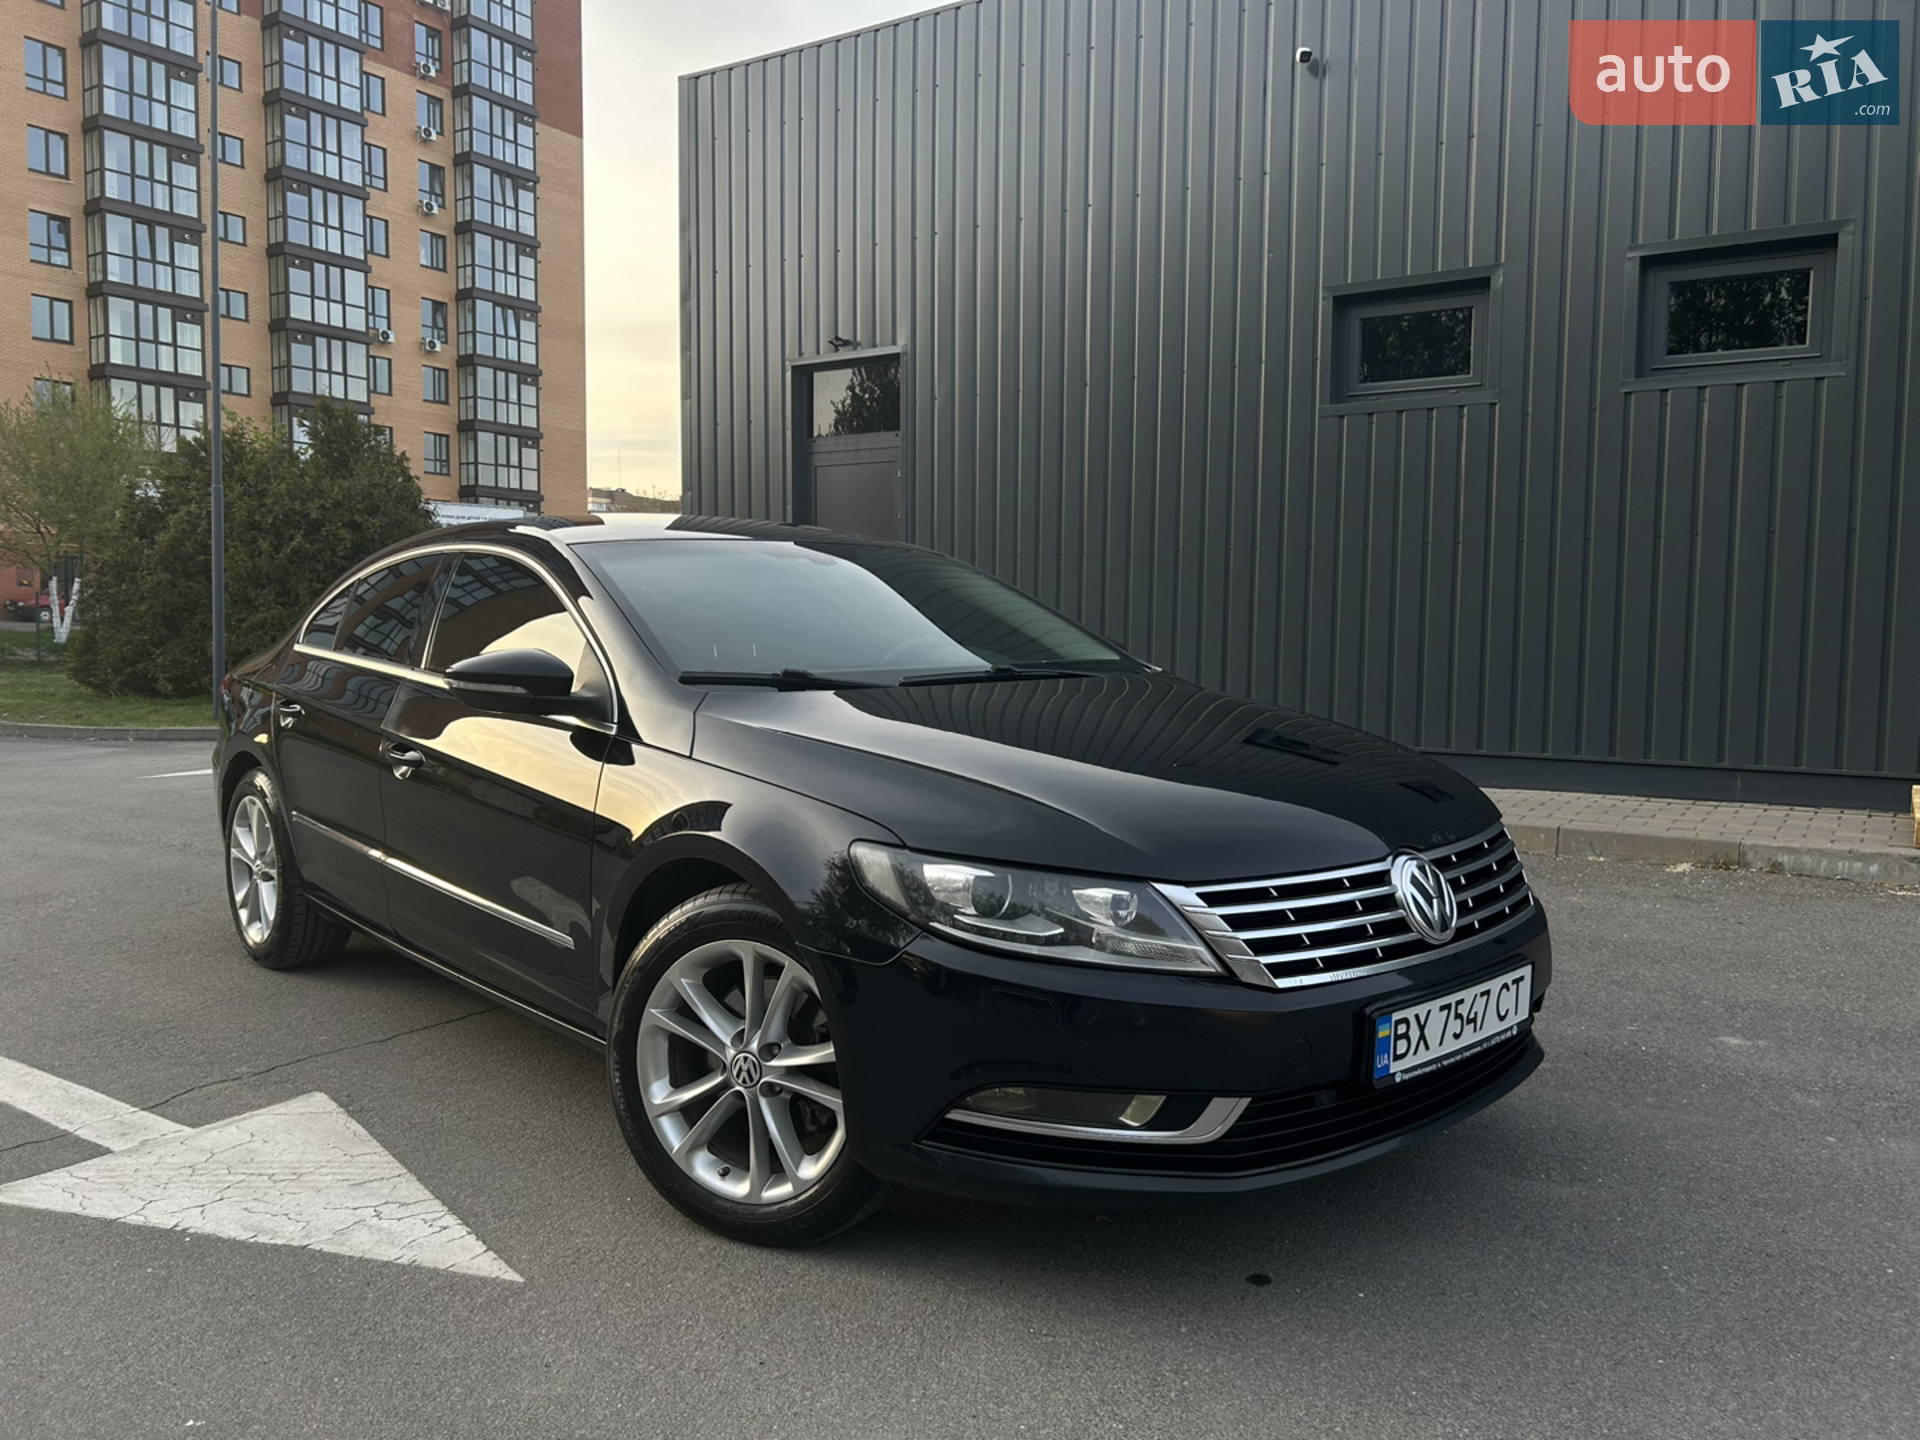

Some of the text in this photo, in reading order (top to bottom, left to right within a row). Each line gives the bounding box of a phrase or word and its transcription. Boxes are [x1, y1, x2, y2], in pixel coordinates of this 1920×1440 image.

[1393, 1009, 1432, 1063] BX
[1438, 988, 1491, 1047] 7547
[1496, 975, 1525, 1022] CT
[1376, 1053, 1389, 1069] UA
